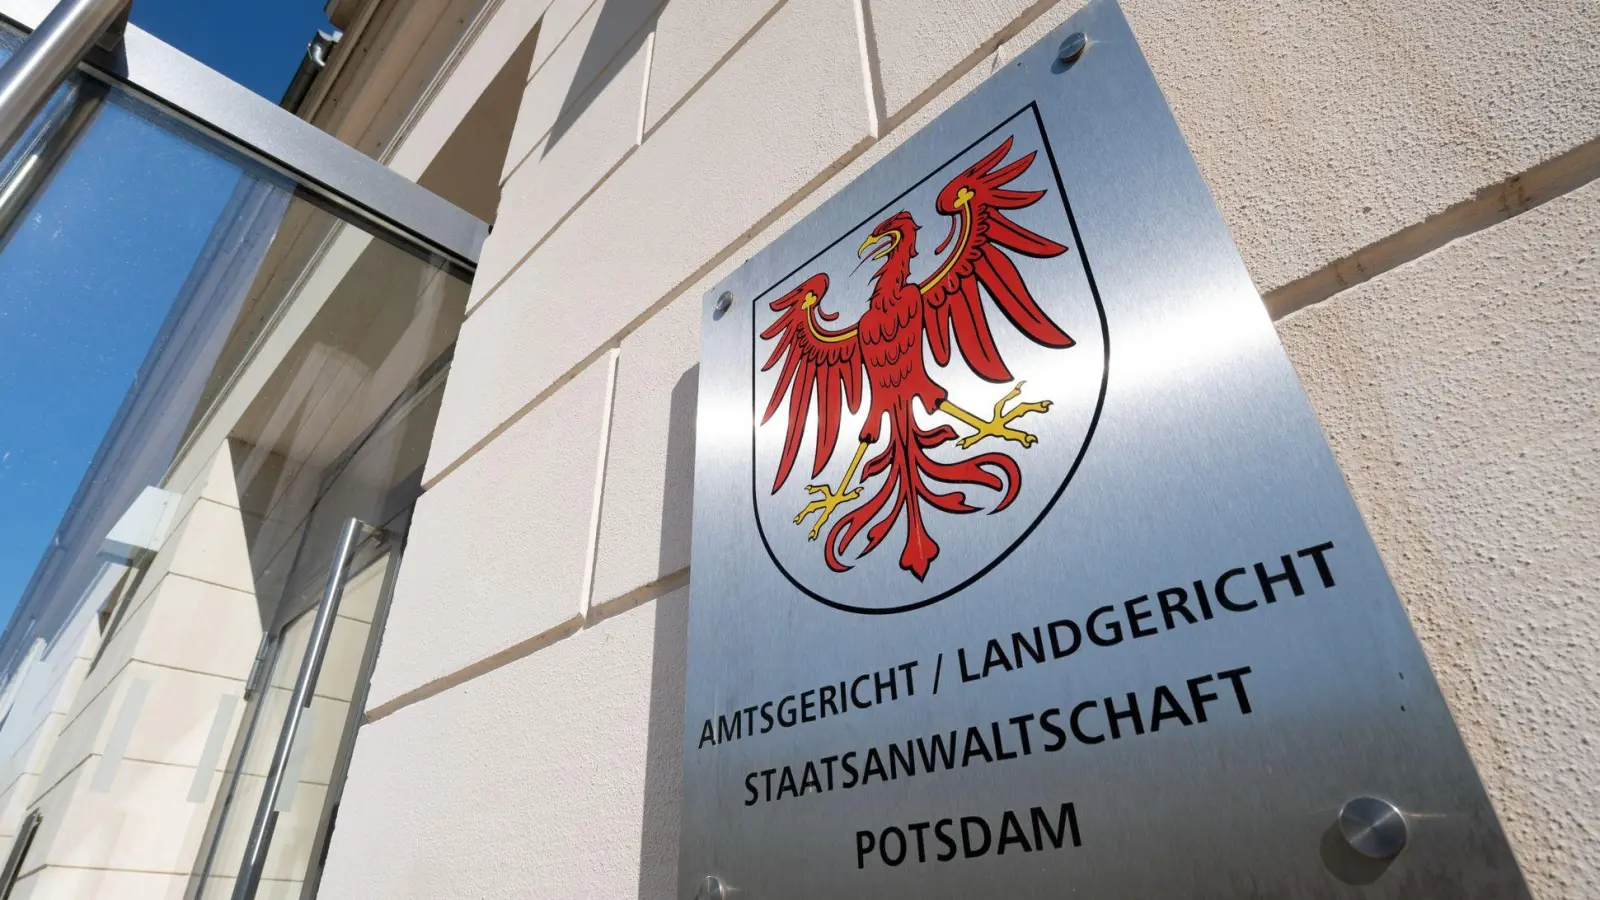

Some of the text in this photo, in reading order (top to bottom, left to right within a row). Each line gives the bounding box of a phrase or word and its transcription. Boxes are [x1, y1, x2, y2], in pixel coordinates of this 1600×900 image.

[698, 541, 1336, 749] AMTSGERICHT / LANDGERICHT
[744, 665, 1253, 807] STAATSANWALTSCHAFT
[855, 801, 1083, 870] POTSDAM
